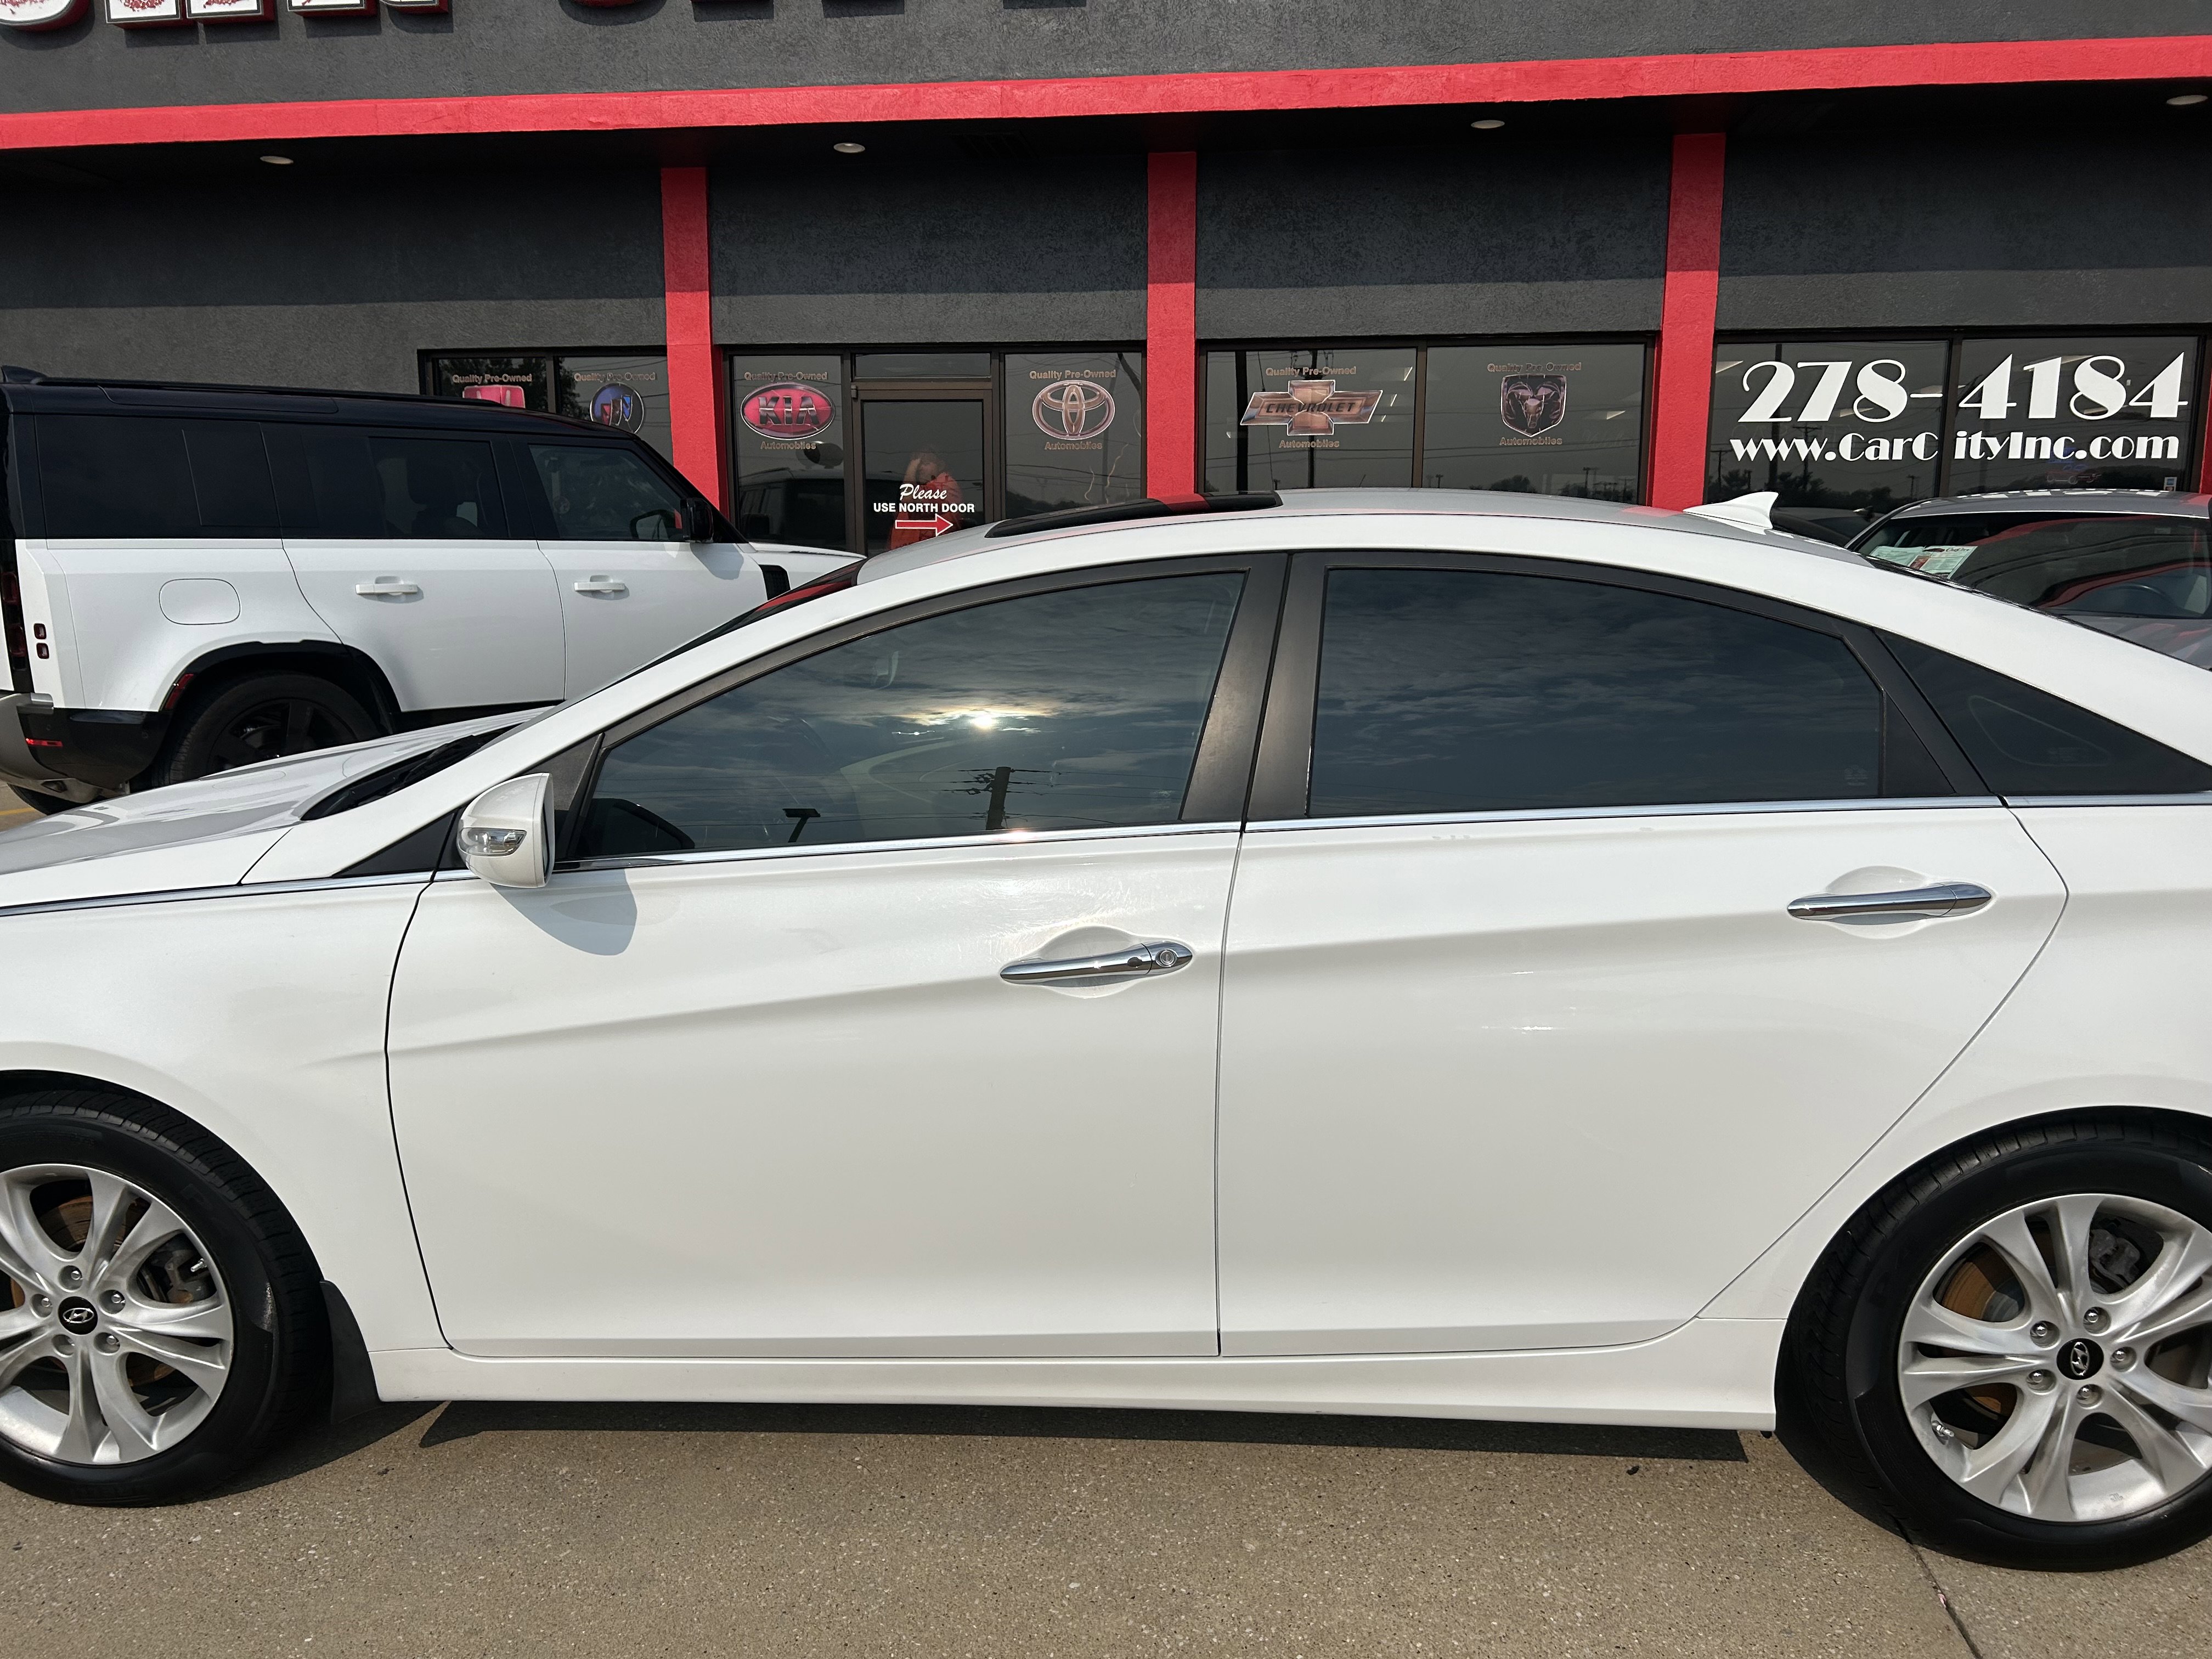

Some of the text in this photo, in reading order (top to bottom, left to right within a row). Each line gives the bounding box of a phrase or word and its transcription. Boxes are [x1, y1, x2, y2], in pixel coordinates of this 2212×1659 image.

[1266, 366, 1357, 377] Quality Pre-Owned
[1487, 362, 1582, 373] Quality PreOwned
[453, 374, 532, 384] Quality Pre-Owned
[574, 373, 603, 382] Quality
[744, 371, 827, 382] Quality Pre-Owned
[1029, 370, 1116, 380] Quality Pre-Owned
[758, 396, 820, 425] KIA
[1266, 403, 1356, 413] CHEVROLET
[760, 441, 816, 450] Automobiles
[1045, 442, 1103, 450] Automobiles
[1279, 439, 1340, 448] Automobiles
[1499, 437, 1562, 445] Automobiles
[899, 483, 947, 500] Please
[873, 503, 974, 512] USE NORTH DOOR
